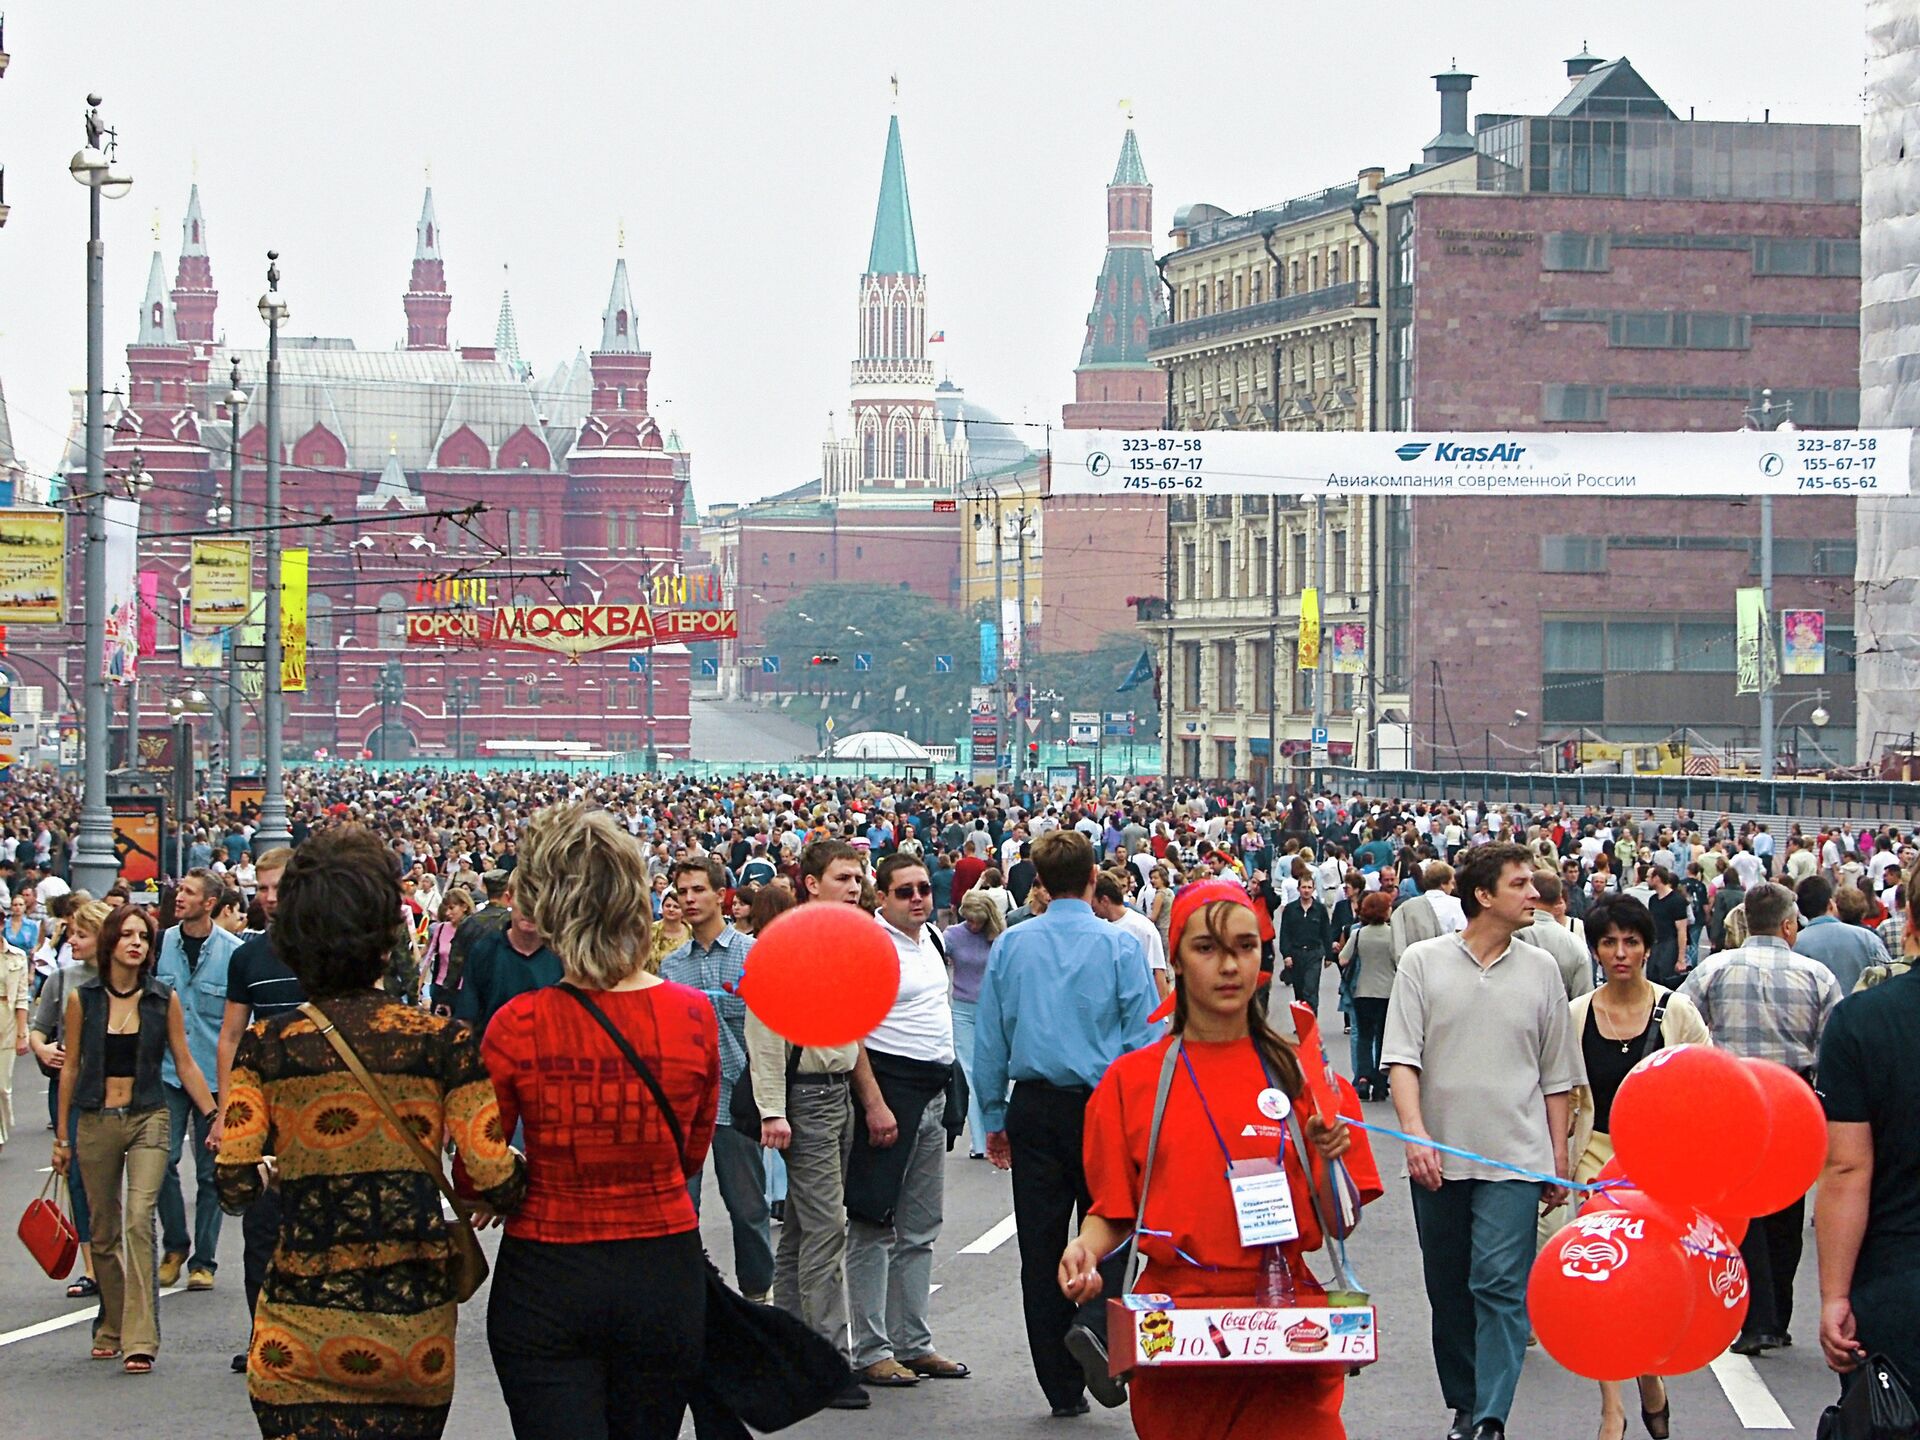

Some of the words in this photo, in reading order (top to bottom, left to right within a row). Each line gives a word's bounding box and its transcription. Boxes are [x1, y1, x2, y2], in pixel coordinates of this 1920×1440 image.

[1122, 439, 1202, 451] 323-87-58
[1797, 438, 1877, 451] 323-87-58
[1435, 443, 1526, 461] KrasAir
[1130, 457, 1203, 470] 155-67-17
[1803, 457, 1876, 470] 155-67-17
[1122, 476, 1203, 489] 745-65-62
[1326, 473, 1453, 487] Авиакомпания
[1458, 472, 1572, 490] современной
[1577, 473, 1636, 487] России
[1797, 476, 1878, 489] 745-65-62
[407, 614, 480, 637] ГОРОД
[492, 606, 655, 640] МОСКВА
[1315, 729, 1326, 743] P
